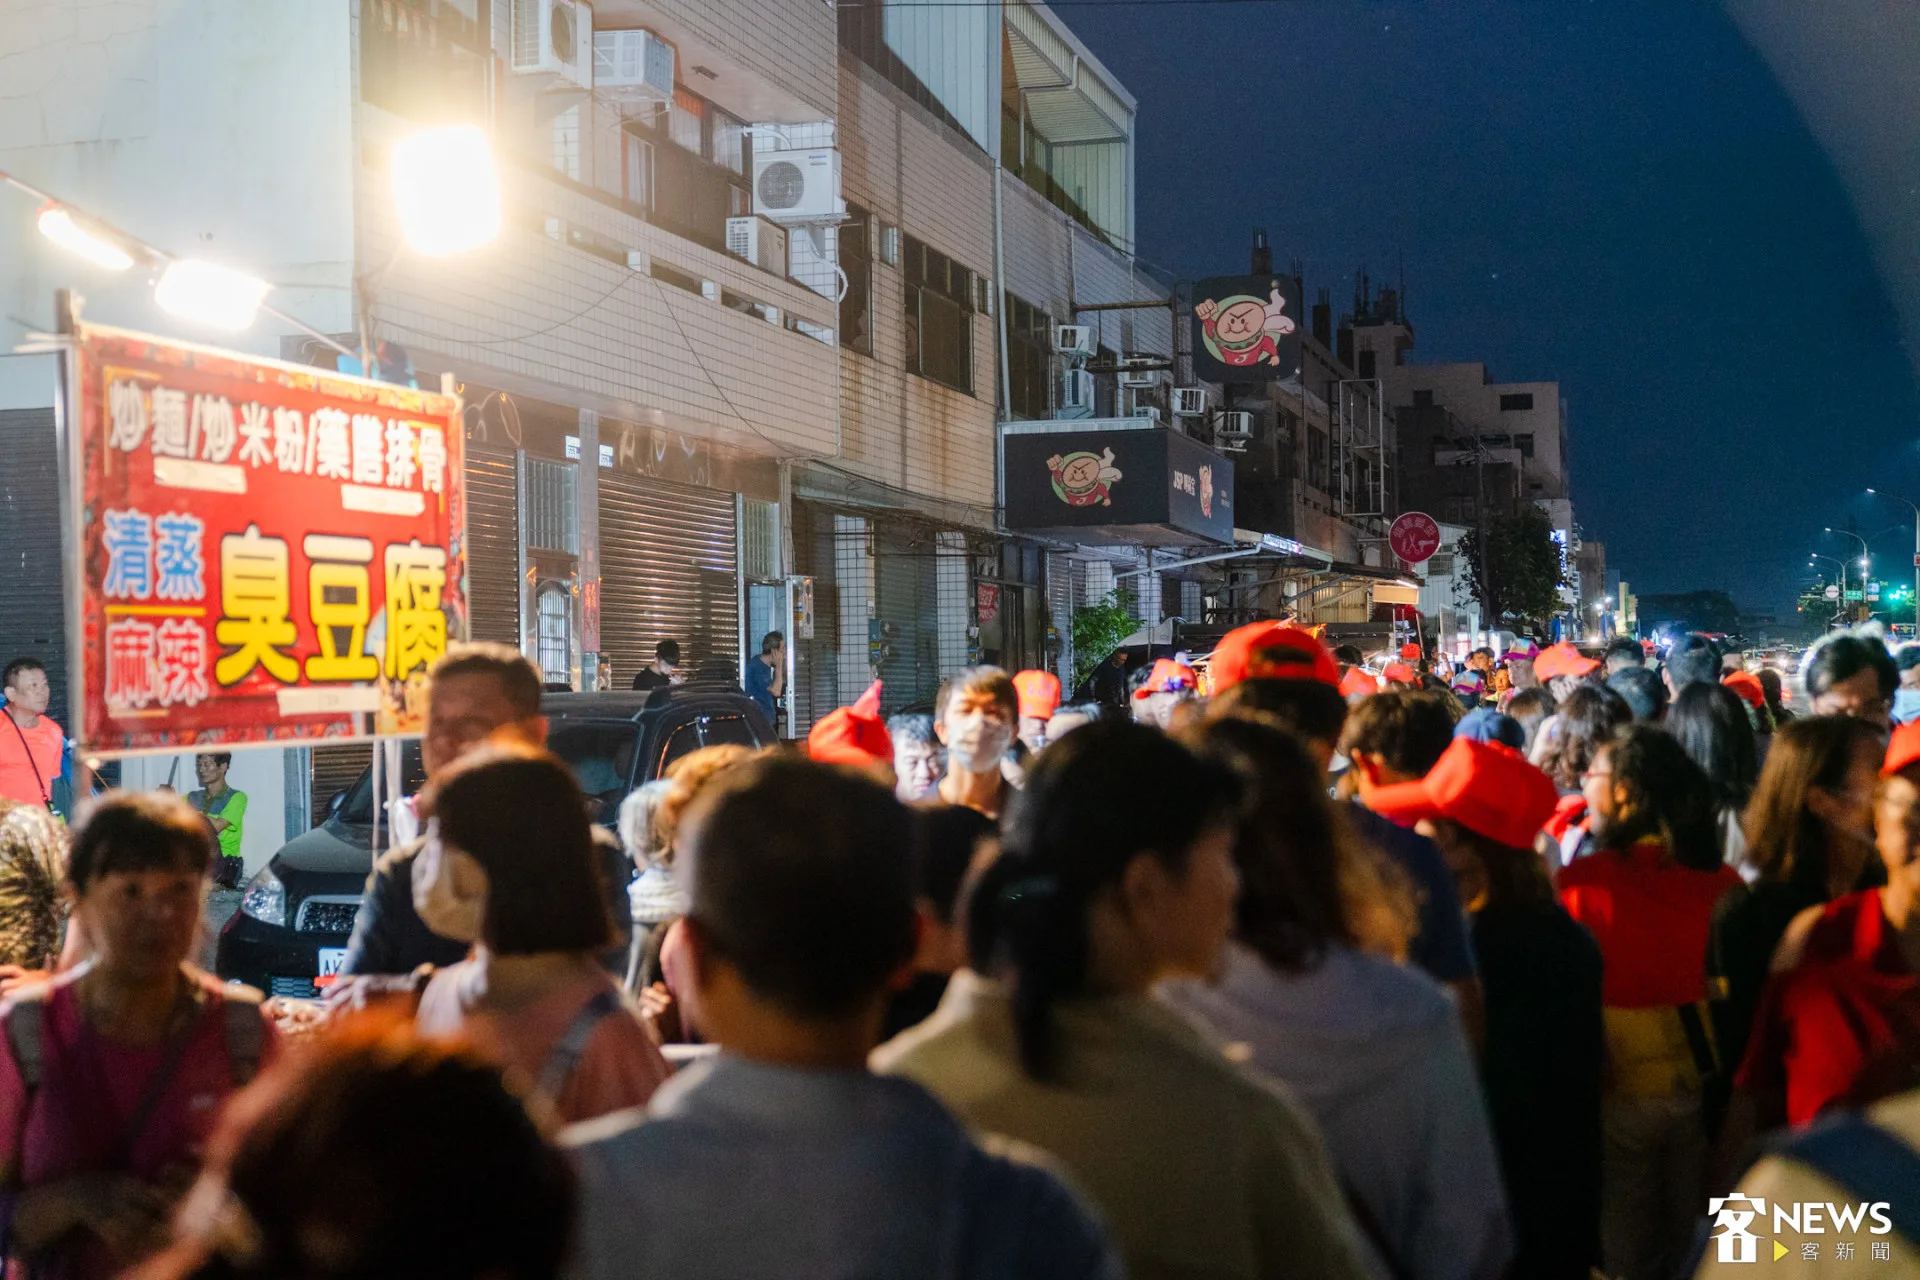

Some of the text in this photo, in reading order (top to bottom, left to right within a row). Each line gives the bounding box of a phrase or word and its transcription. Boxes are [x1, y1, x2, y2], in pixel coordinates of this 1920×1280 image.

[103, 508, 205, 600] 清蒸
[215, 523, 447, 686] 臭豆腐
[104, 618, 209, 706] 麻辣
